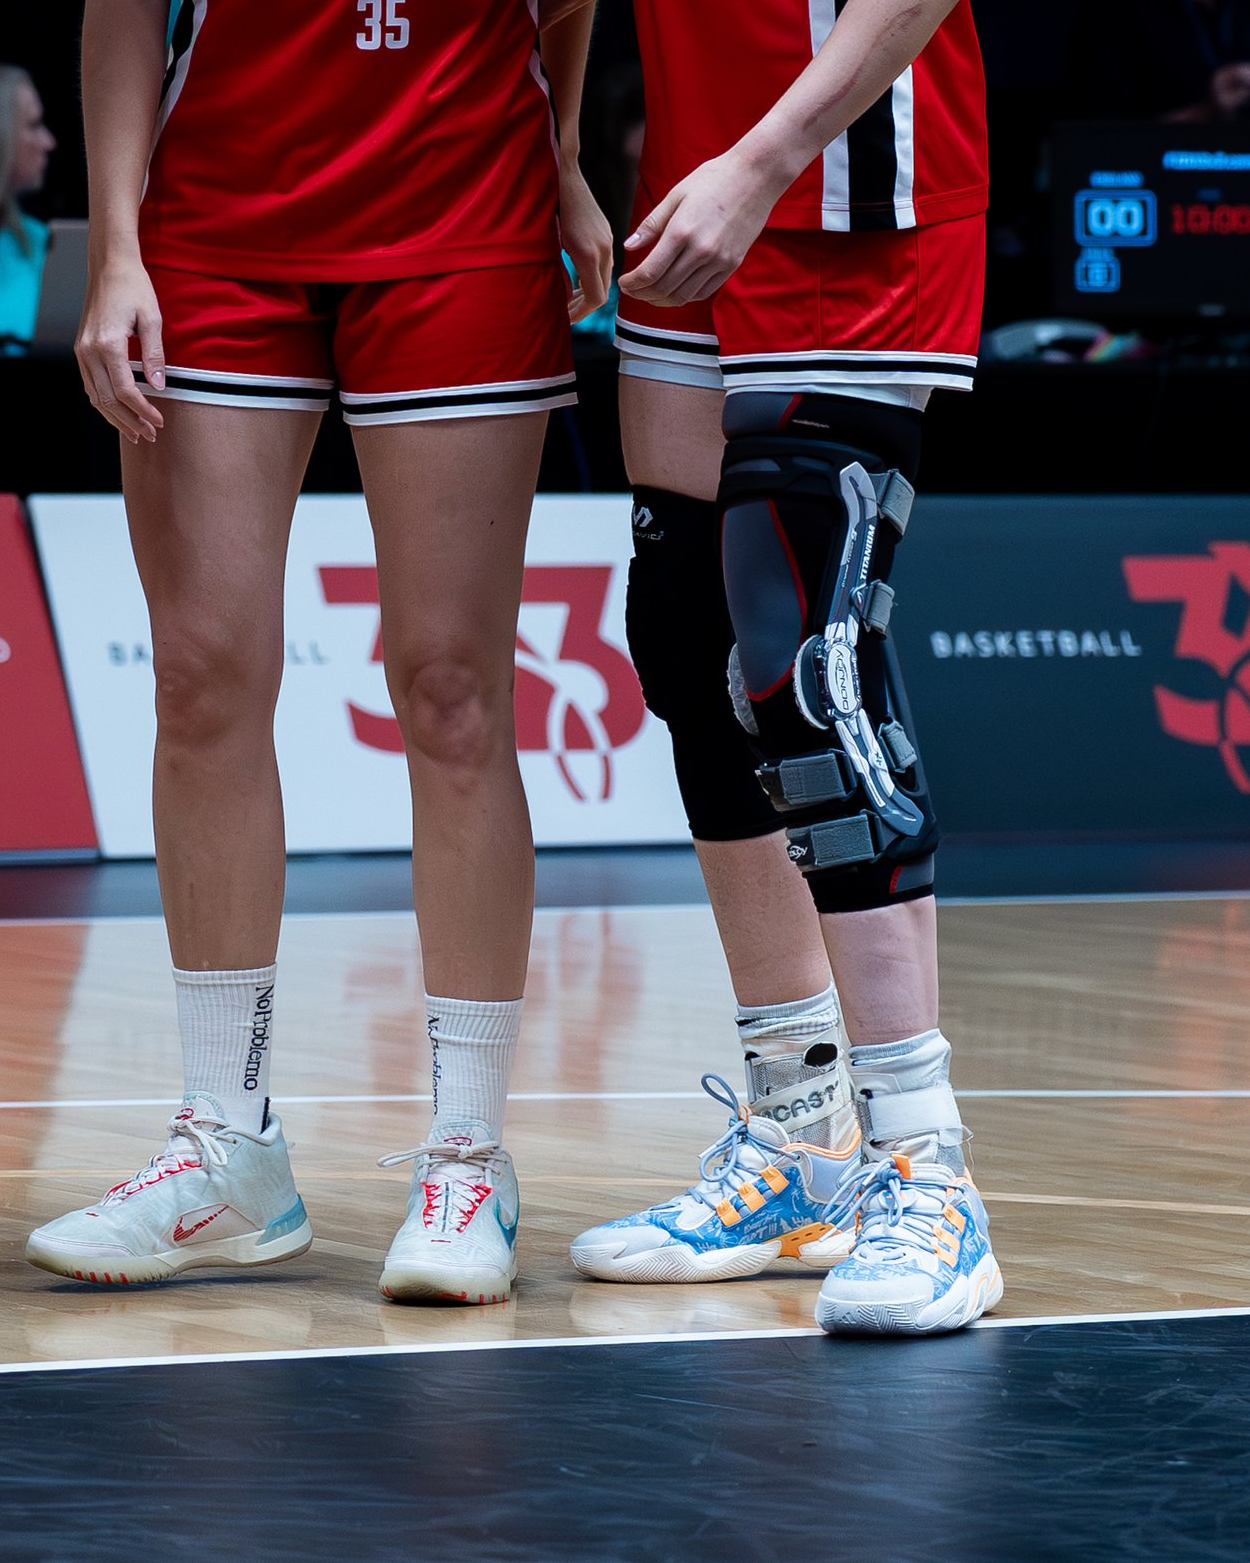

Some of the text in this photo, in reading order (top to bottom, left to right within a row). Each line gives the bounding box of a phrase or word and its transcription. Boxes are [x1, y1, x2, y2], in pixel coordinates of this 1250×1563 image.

[1087, 199, 1145, 237] 00
[860, 524, 875, 580] TITANIUM
[930, 630, 1143, 658] BASKETBALL
[244, 983, 275, 1091] NoProblemo
